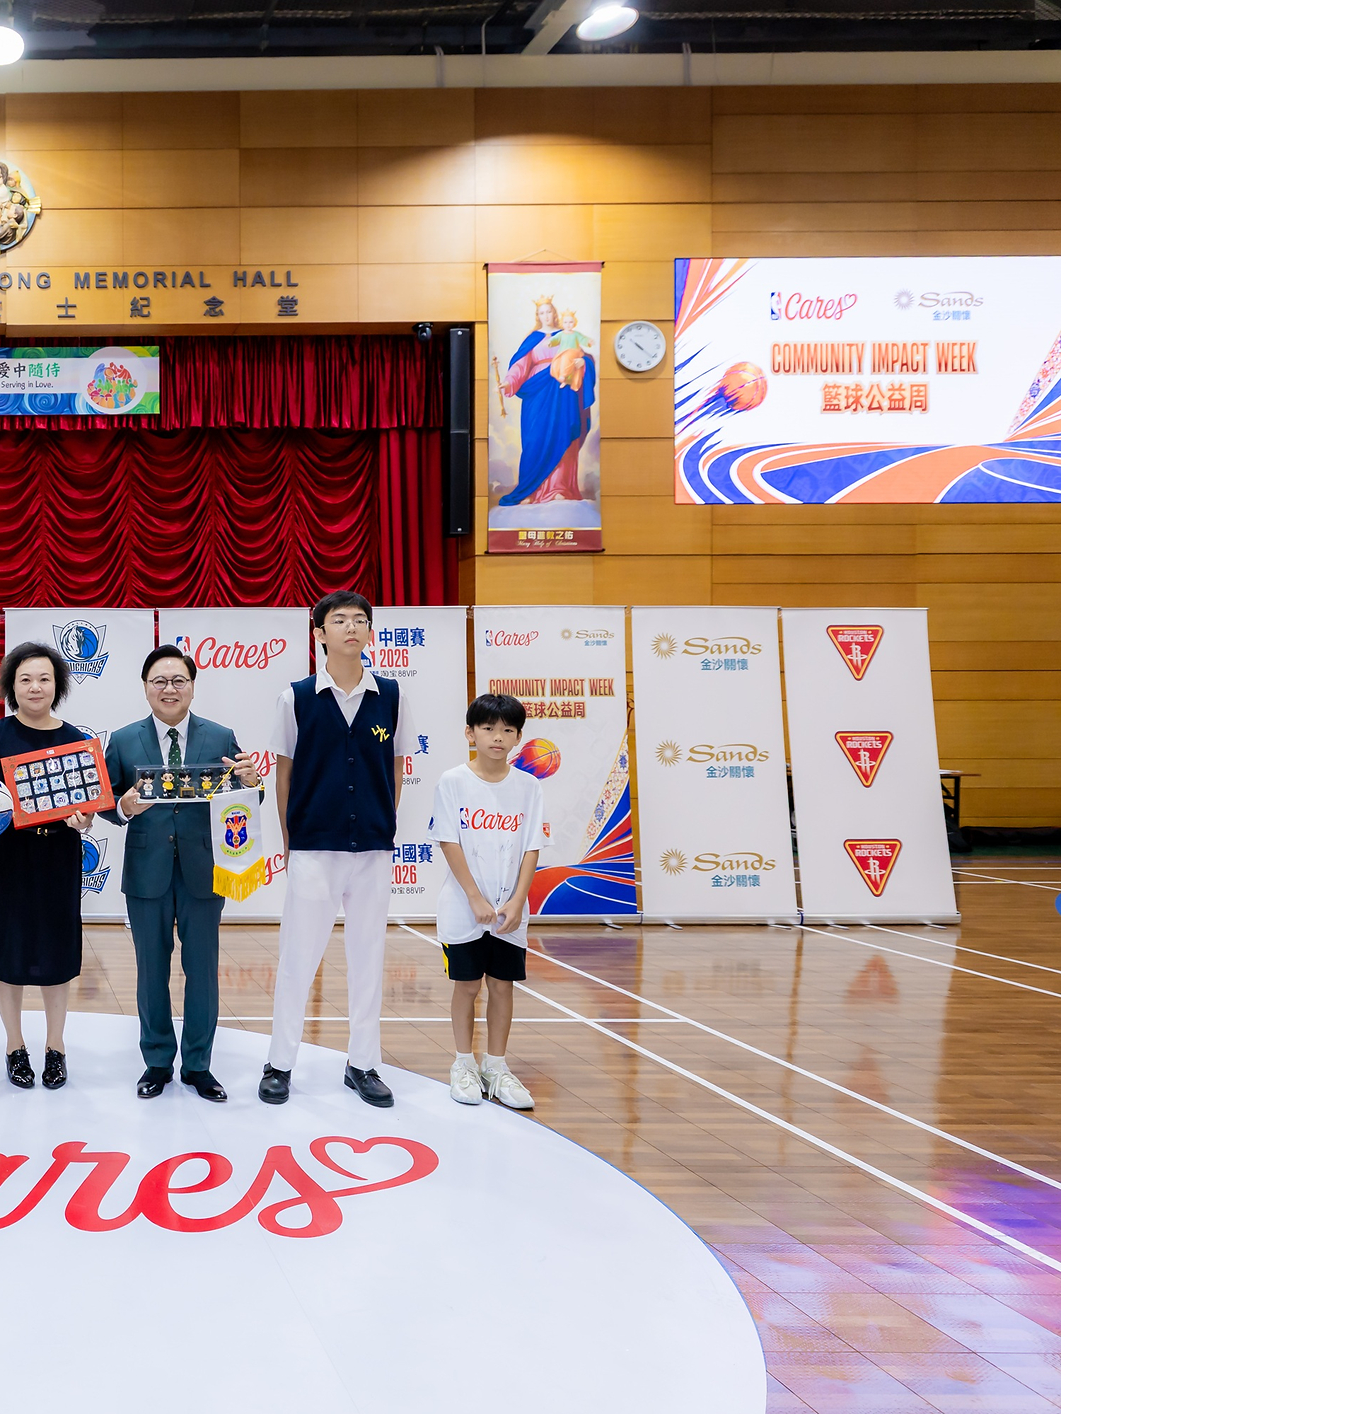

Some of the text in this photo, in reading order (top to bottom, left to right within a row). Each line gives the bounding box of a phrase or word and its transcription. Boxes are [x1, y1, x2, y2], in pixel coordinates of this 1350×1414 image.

[74, 271, 211, 289] MEMORIAL
[233, 270, 299, 288] HALL
[785, 292, 857, 320] Cares
[918, 291, 984, 307] Sands
[772, 342, 977, 373] COMMUNITY IMPACT WEEK
[1, 381, 26, 390] Serving
[822, 383, 928, 411] 籃球公益周
[379, 627, 425, 647] 中國賽
[495, 630, 539, 646] Cares
[575, 629, 615, 639] Sands
[195, 637, 287, 670] Cares
[681, 636, 762, 656] Sands
[379, 649, 409, 668] 2026
[490, 679, 614, 696] COMMUNITY IMPACT WEEK
[686, 743, 769, 763] Sands
[471, 809, 524, 832] Cares
[692, 852, 776, 871] Sands
[392, 865, 417, 884] 026
